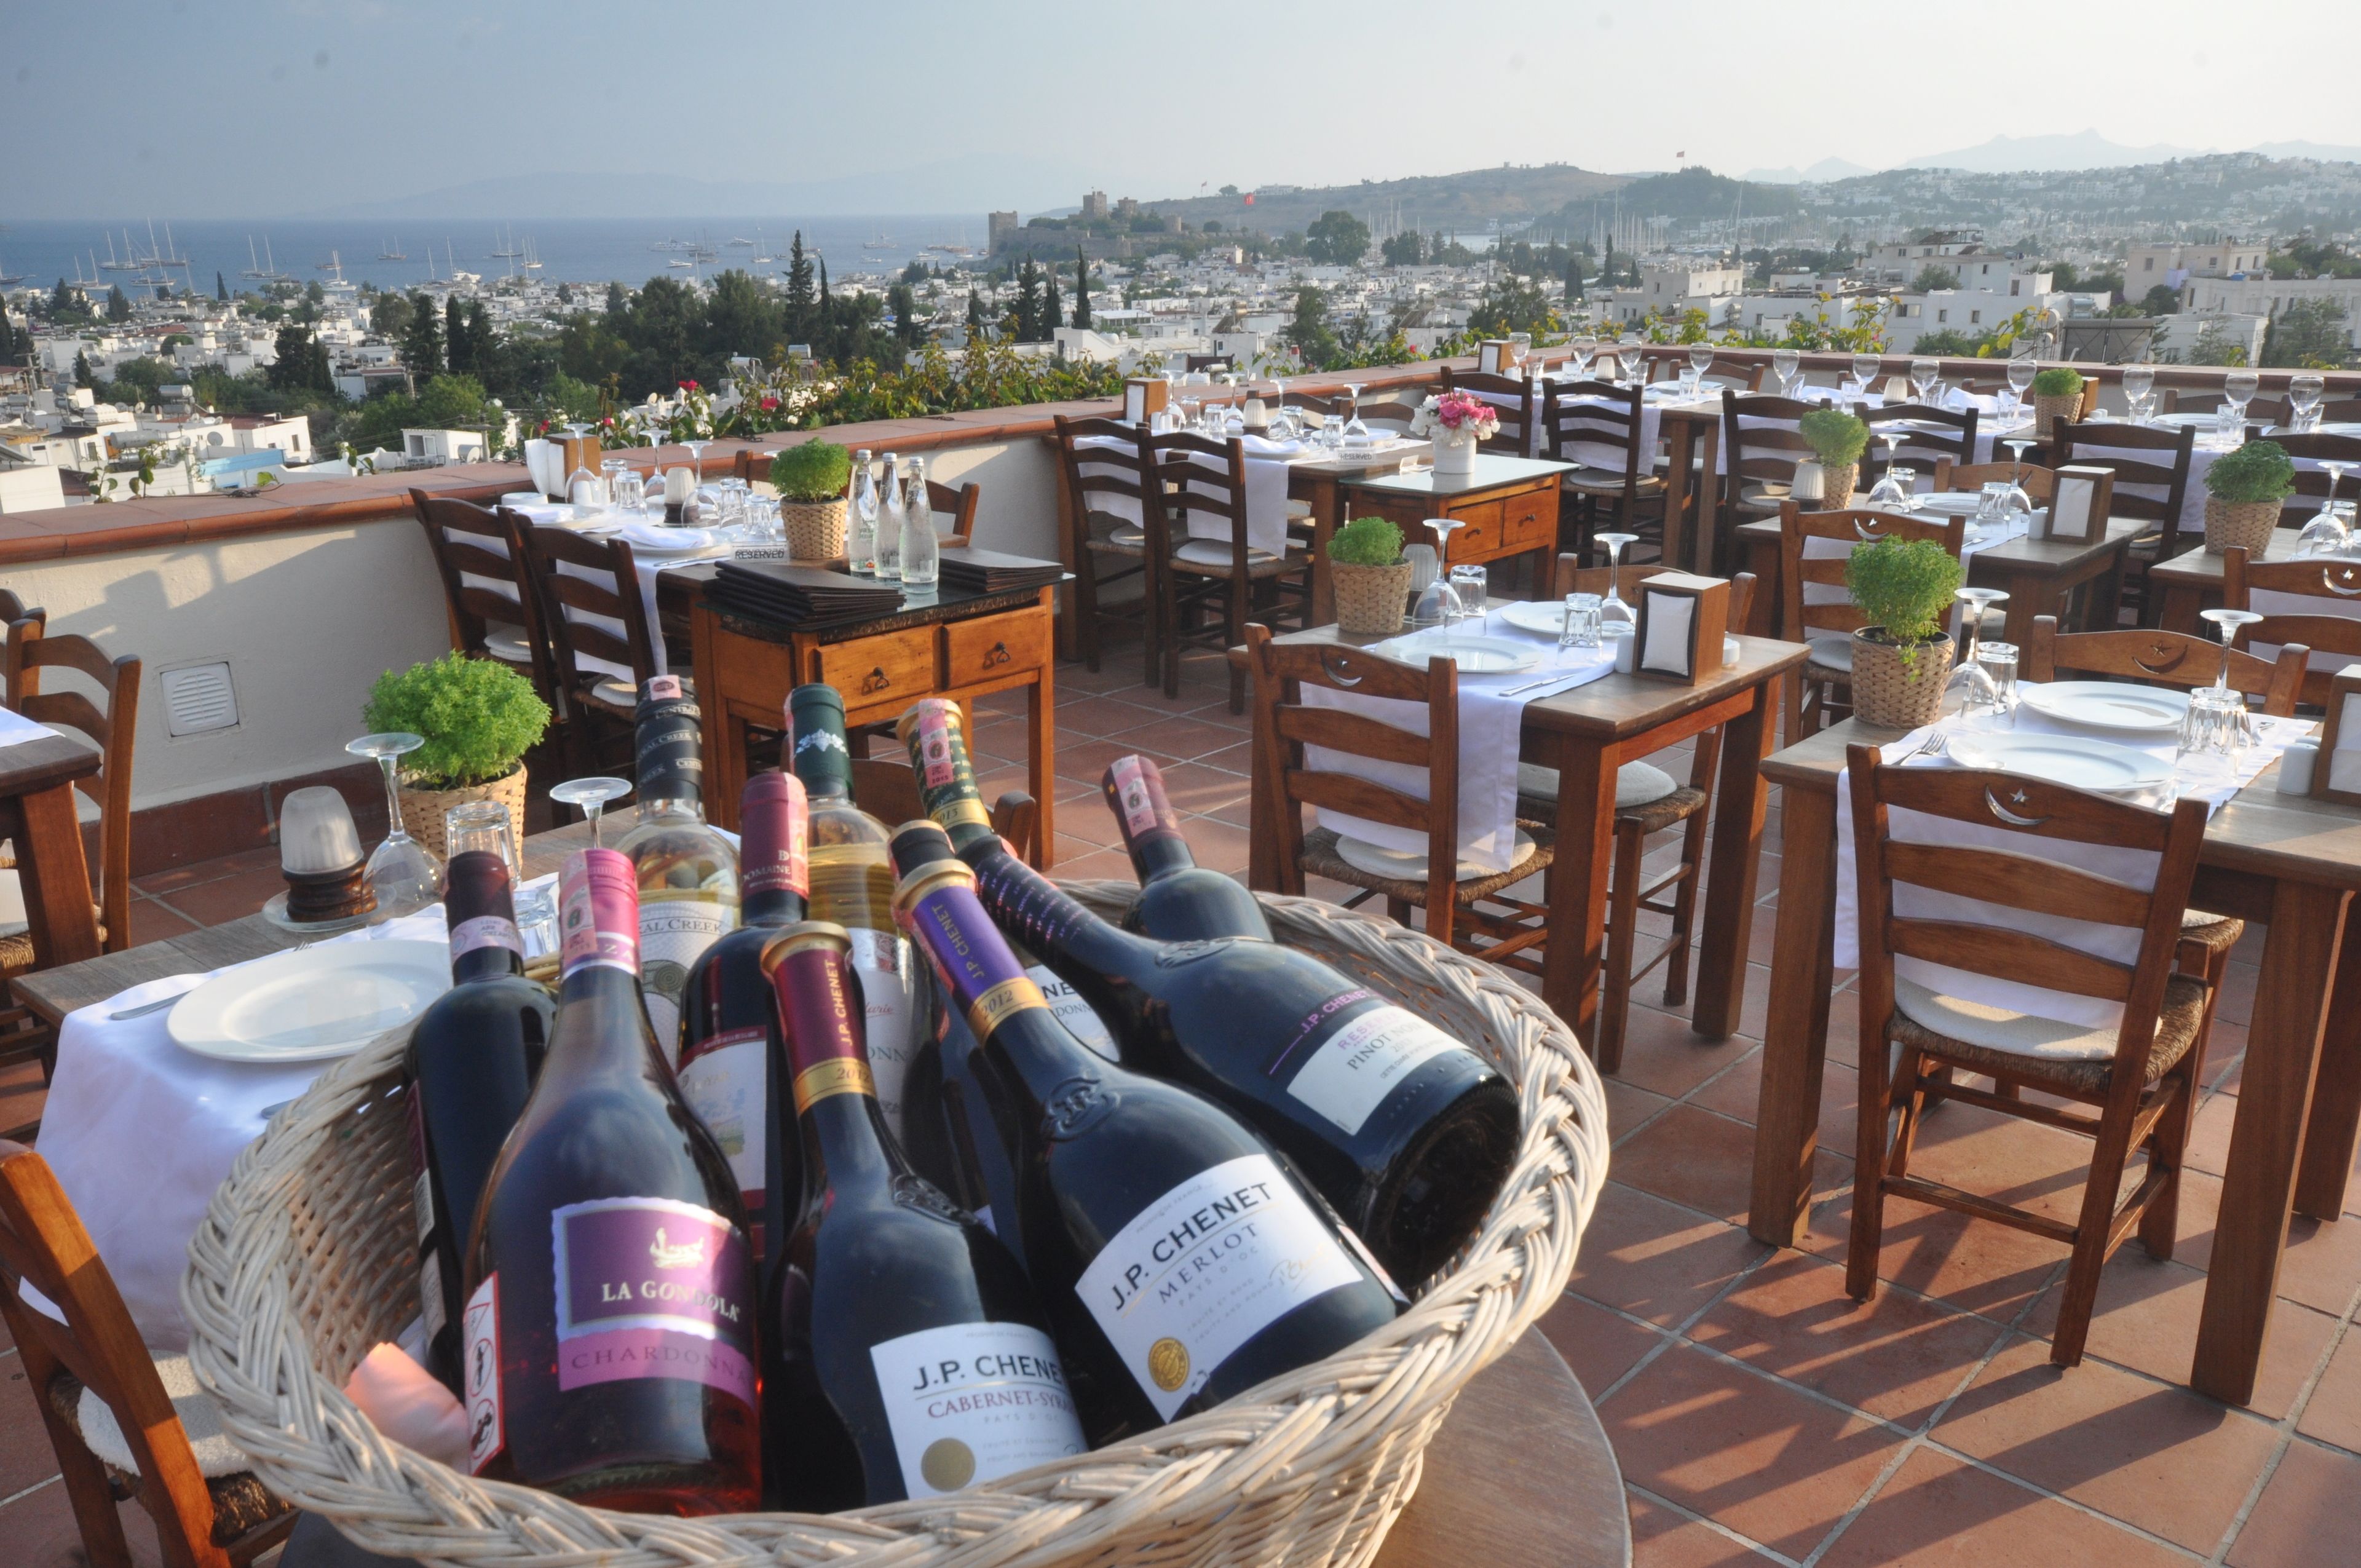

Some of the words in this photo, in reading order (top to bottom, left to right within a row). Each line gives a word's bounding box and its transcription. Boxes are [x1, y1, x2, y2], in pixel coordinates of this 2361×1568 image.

[735, 550, 785, 559] RESERVED
[668, 919, 722, 933] CREEK
[931, 904, 970, 956] CHENET
[825, 959, 847, 1018] CHENET
[1323, 990, 1372, 1013] CHENET
[981, 990, 1014, 1020] 2012
[1347, 1032, 1392, 1071] PINOT
[1152, 1182, 1271, 1262] CHENET
[1158, 1223, 1257, 1304] MERLOT
[602, 1281, 633, 1302] LA
[641, 1280, 739, 1322] GONDOLA
[1179, 1277, 1212, 1307] PAYS
[571, 1345, 749, 1382] CHARDONNA
[975, 1354, 1064, 1384] CHENE
[927, 1390, 1075, 1419] CABERNET-SYRA
[984, 1413, 1021, 1424] PAYS
